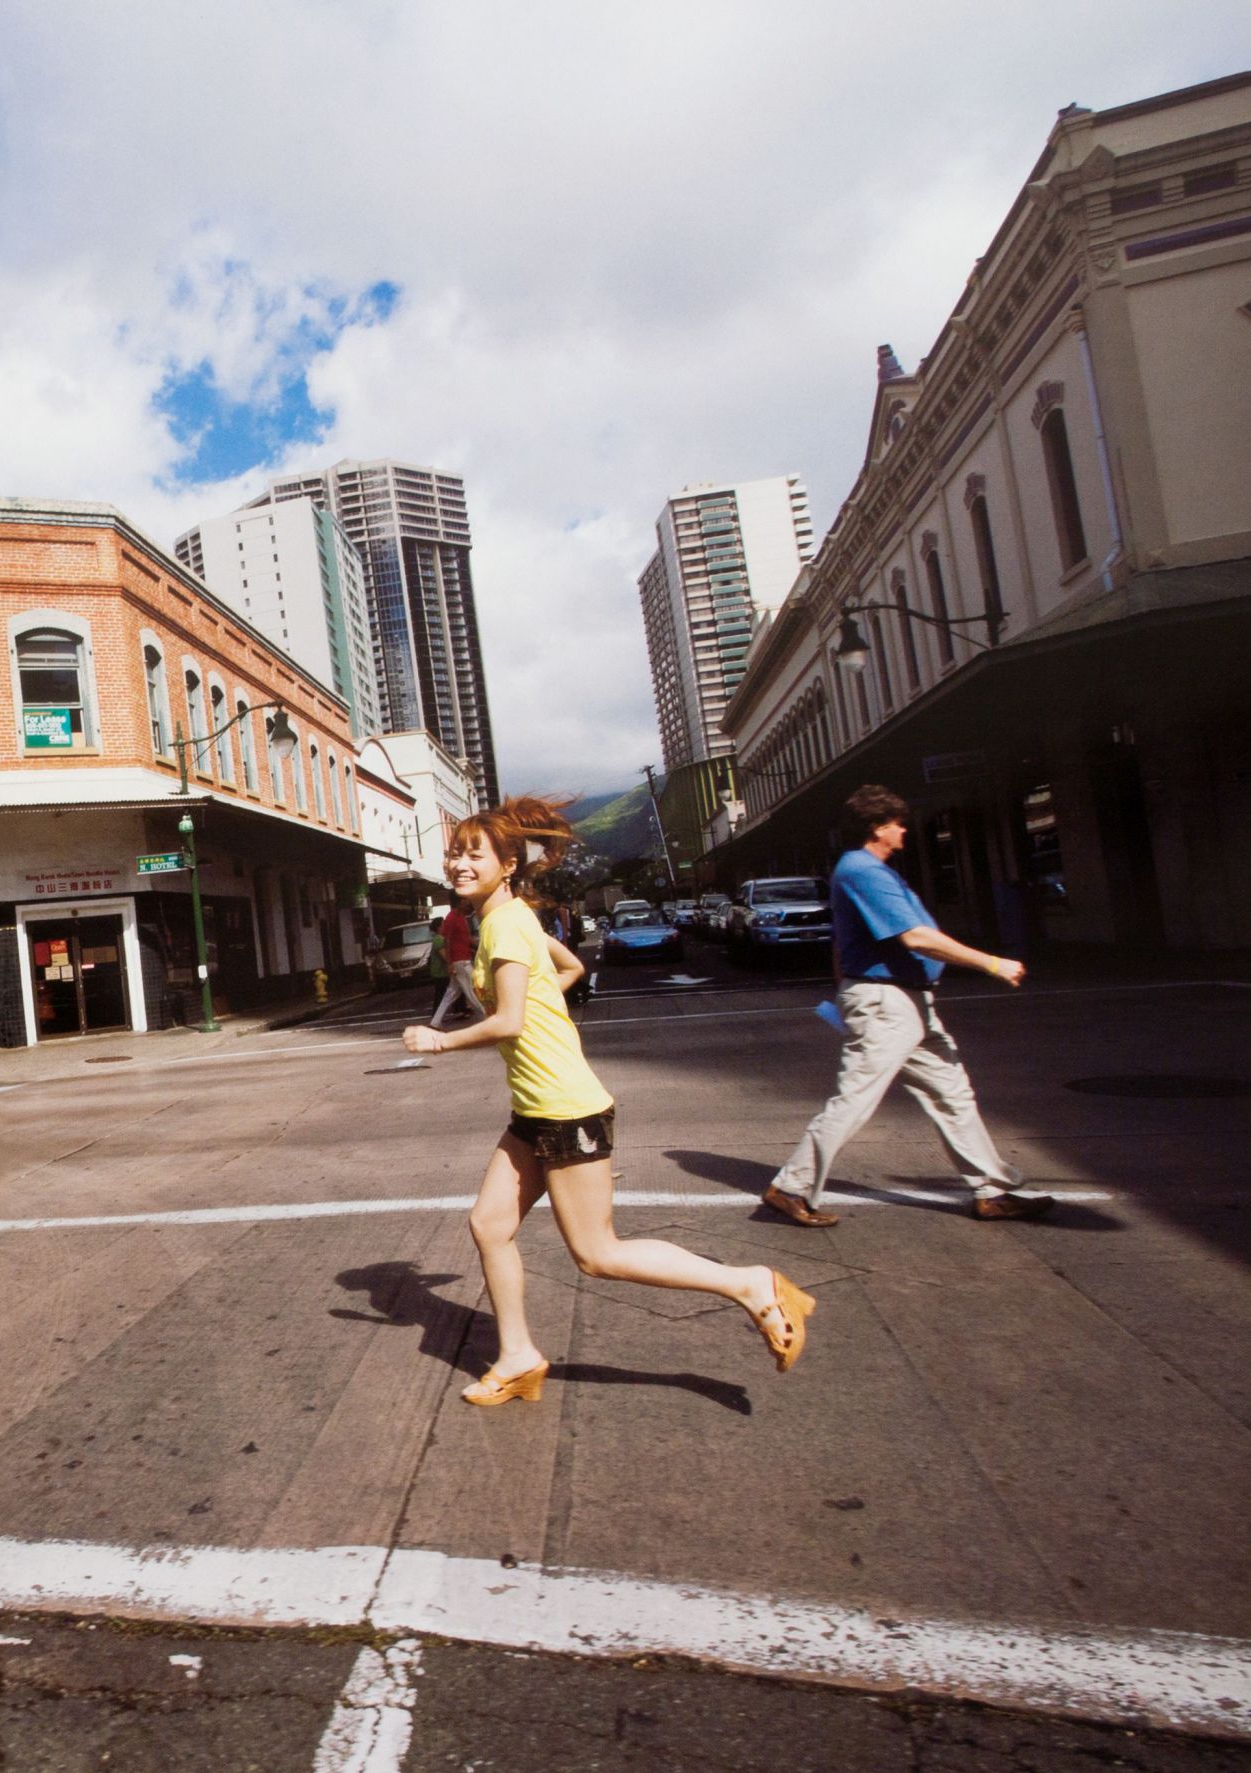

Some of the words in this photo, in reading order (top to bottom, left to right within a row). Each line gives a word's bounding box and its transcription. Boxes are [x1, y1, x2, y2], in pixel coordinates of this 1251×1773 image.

[24, 715, 38, 723] For
[41, 715, 66, 723] Lease
[150, 862, 177, 870] HOTEL
